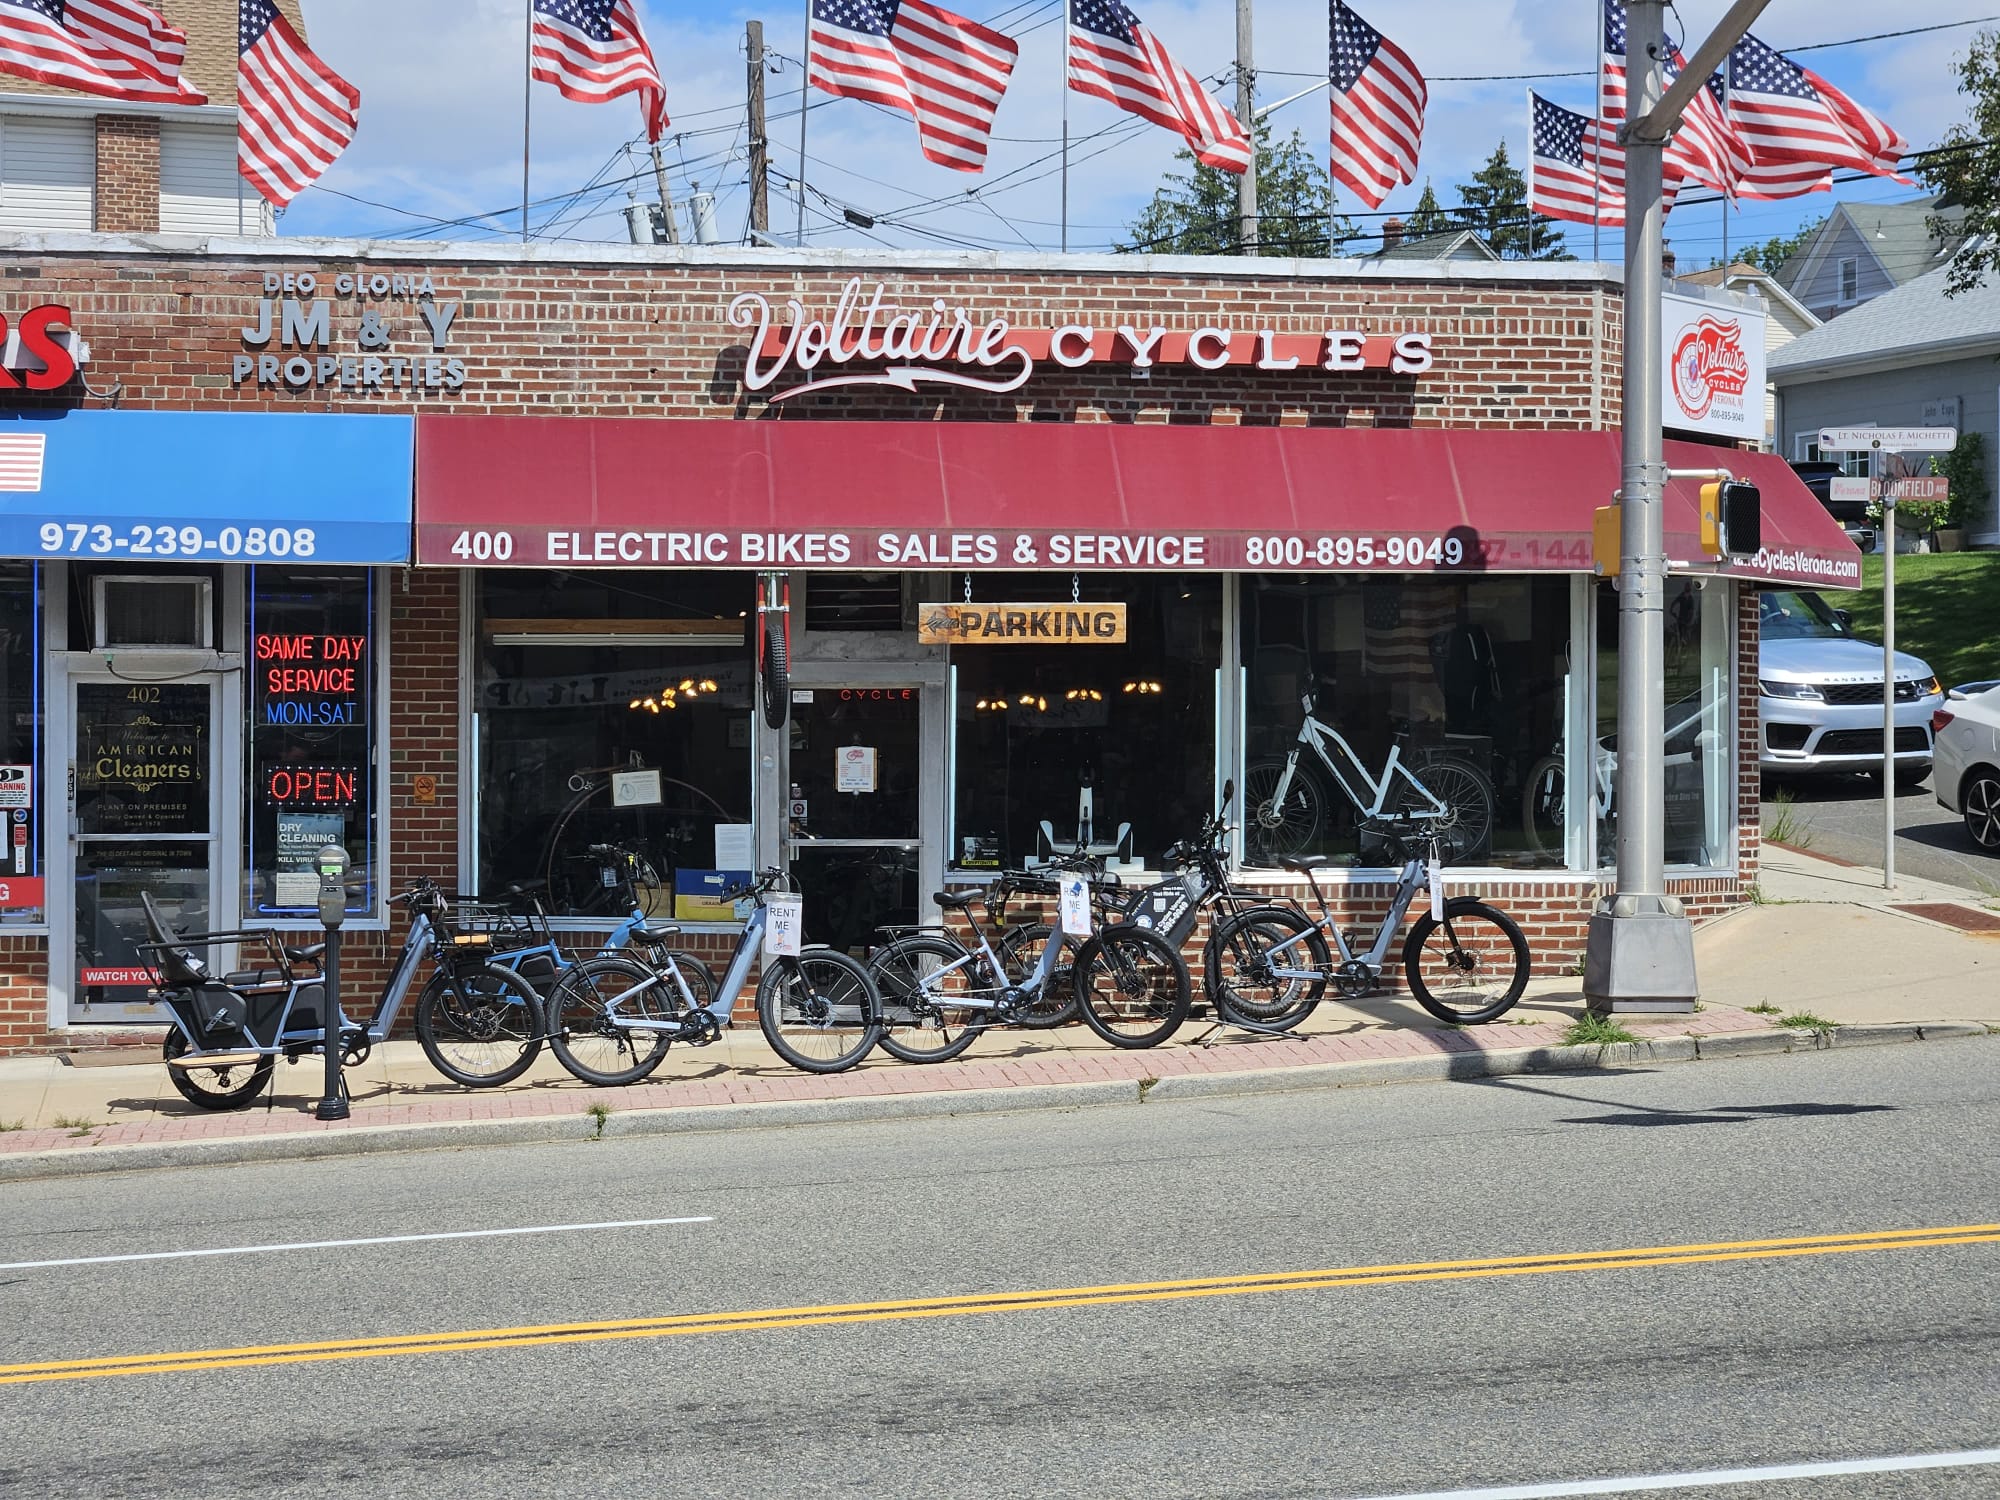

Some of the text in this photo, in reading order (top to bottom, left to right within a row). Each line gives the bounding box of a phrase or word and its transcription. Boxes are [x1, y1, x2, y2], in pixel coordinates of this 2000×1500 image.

[264, 272, 436, 296] DEO GLORIA
[241, 299, 458, 348] JM & Y
[728, 277, 1434, 393] Voltaire CYCLES
[1697, 337, 1748, 376] Voltaire
[233, 355, 465, 388] PROPERTIES
[1708, 378, 1741, 392] CYCLES
[1851, 431, 1896, 441] NICHOLAS
[1907, 431, 1950, 440] MICHETTI
[1871, 479, 1934, 498] BLOOMFIELD
[1935, 486, 1948, 495] AVE
[39, 522, 316, 557] 973-239-0808
[451, 530, 513, 561] 400
[546, 532, 729, 562] ELECTRIC
[740, 533, 851, 563] BIKES
[877, 533, 998, 564] SALES
[1012, 534, 1039, 564] &
[1049, 535, 1205, 566] SERVICE
[1245, 536, 1464, 566] 800-895-9049
[960, 612, 1116, 638] PARKING
[256, 635, 364, 661] SAME DAY
[268, 668, 356, 693] SERVICE
[127, 687, 160, 703] 402
[840, 689, 912, 701] CYCLE
[267, 702, 357, 725] MON-SAT
[97, 744, 192, 756] AMERICAN
[95, 757, 191, 778] Cleaners
[271, 771, 353, 800] OPEN
[98, 803, 188, 811] PLANT ON PREMISES
[279, 823, 302, 832] DRY
[279, 833, 336, 843] CLEANING
[769, 907, 796, 918] RENT
[1069, 900, 1081, 910] ME
[774, 920, 790, 931] ME
[86, 971, 128, 982] WATCH
